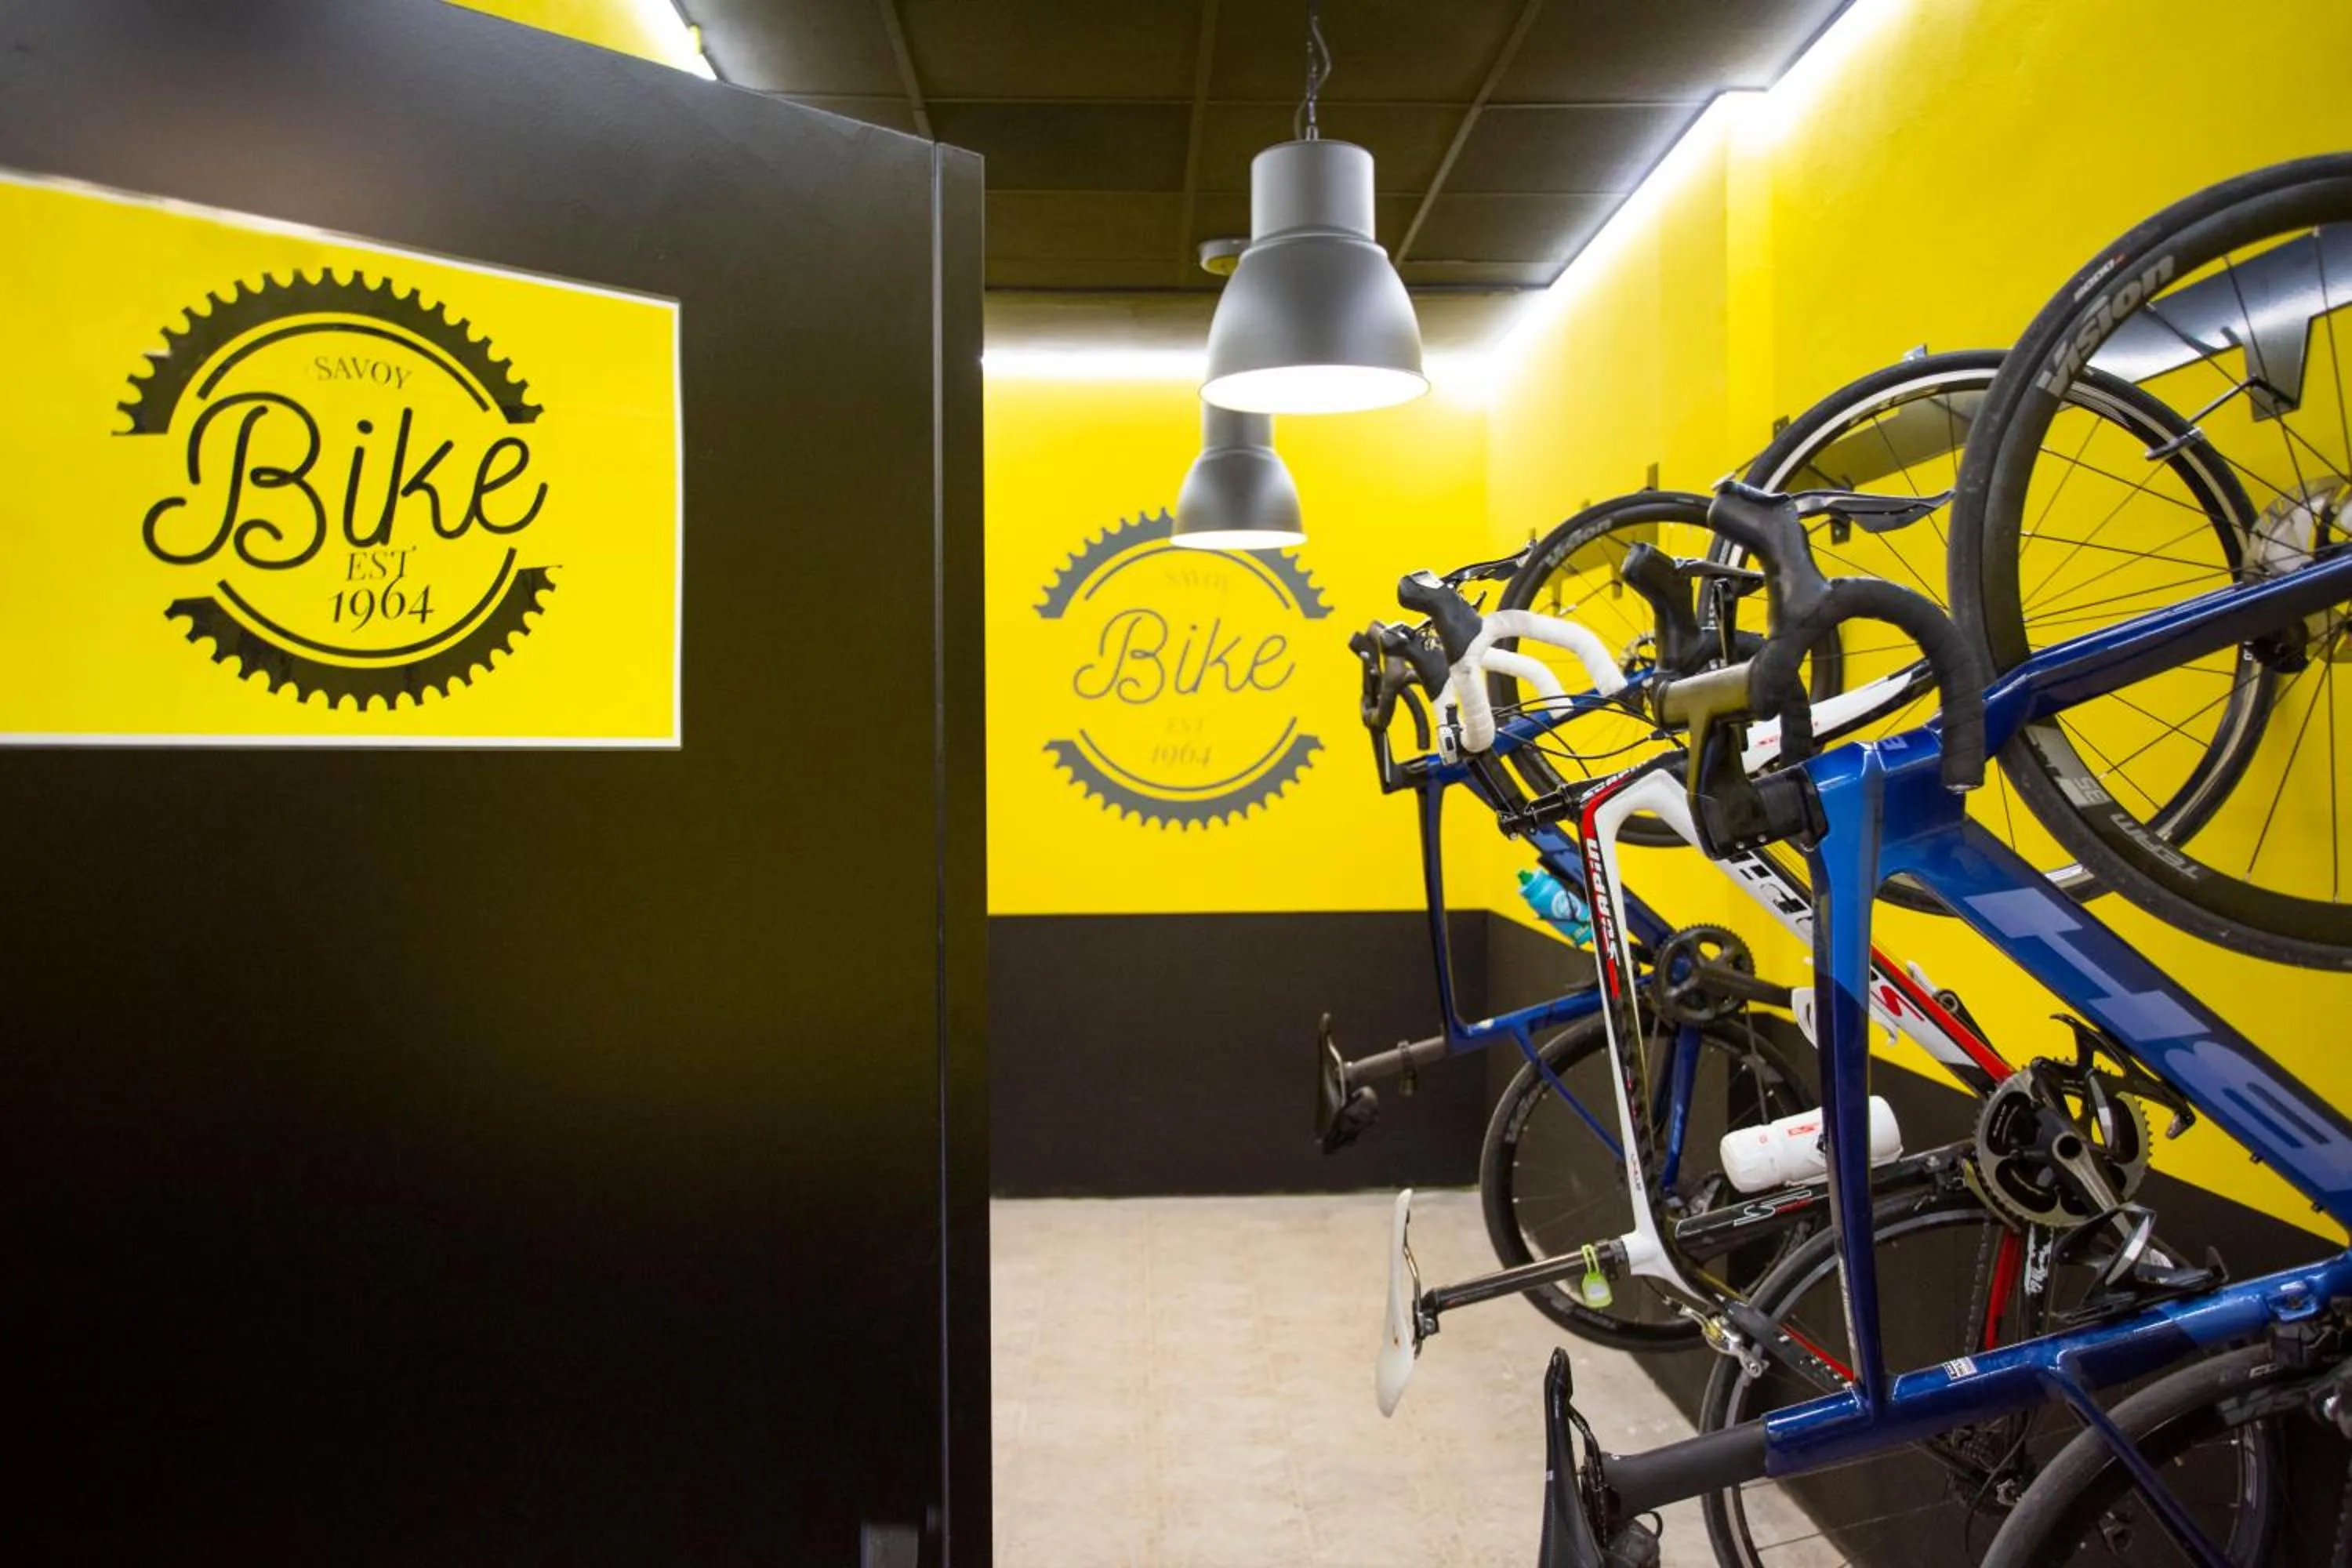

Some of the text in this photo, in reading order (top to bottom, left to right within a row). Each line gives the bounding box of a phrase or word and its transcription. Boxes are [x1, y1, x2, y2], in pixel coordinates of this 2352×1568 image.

[2036, 255, 2175, 397] Vision
[314, 355, 412, 390] SAVOY
[142, 392, 548, 571] Bike
[345, 545, 417, 582] EST
[328, 575, 435, 633] 1964
[1073, 608, 1296, 705] Bike
[1150, 741, 1213, 768] 1964
